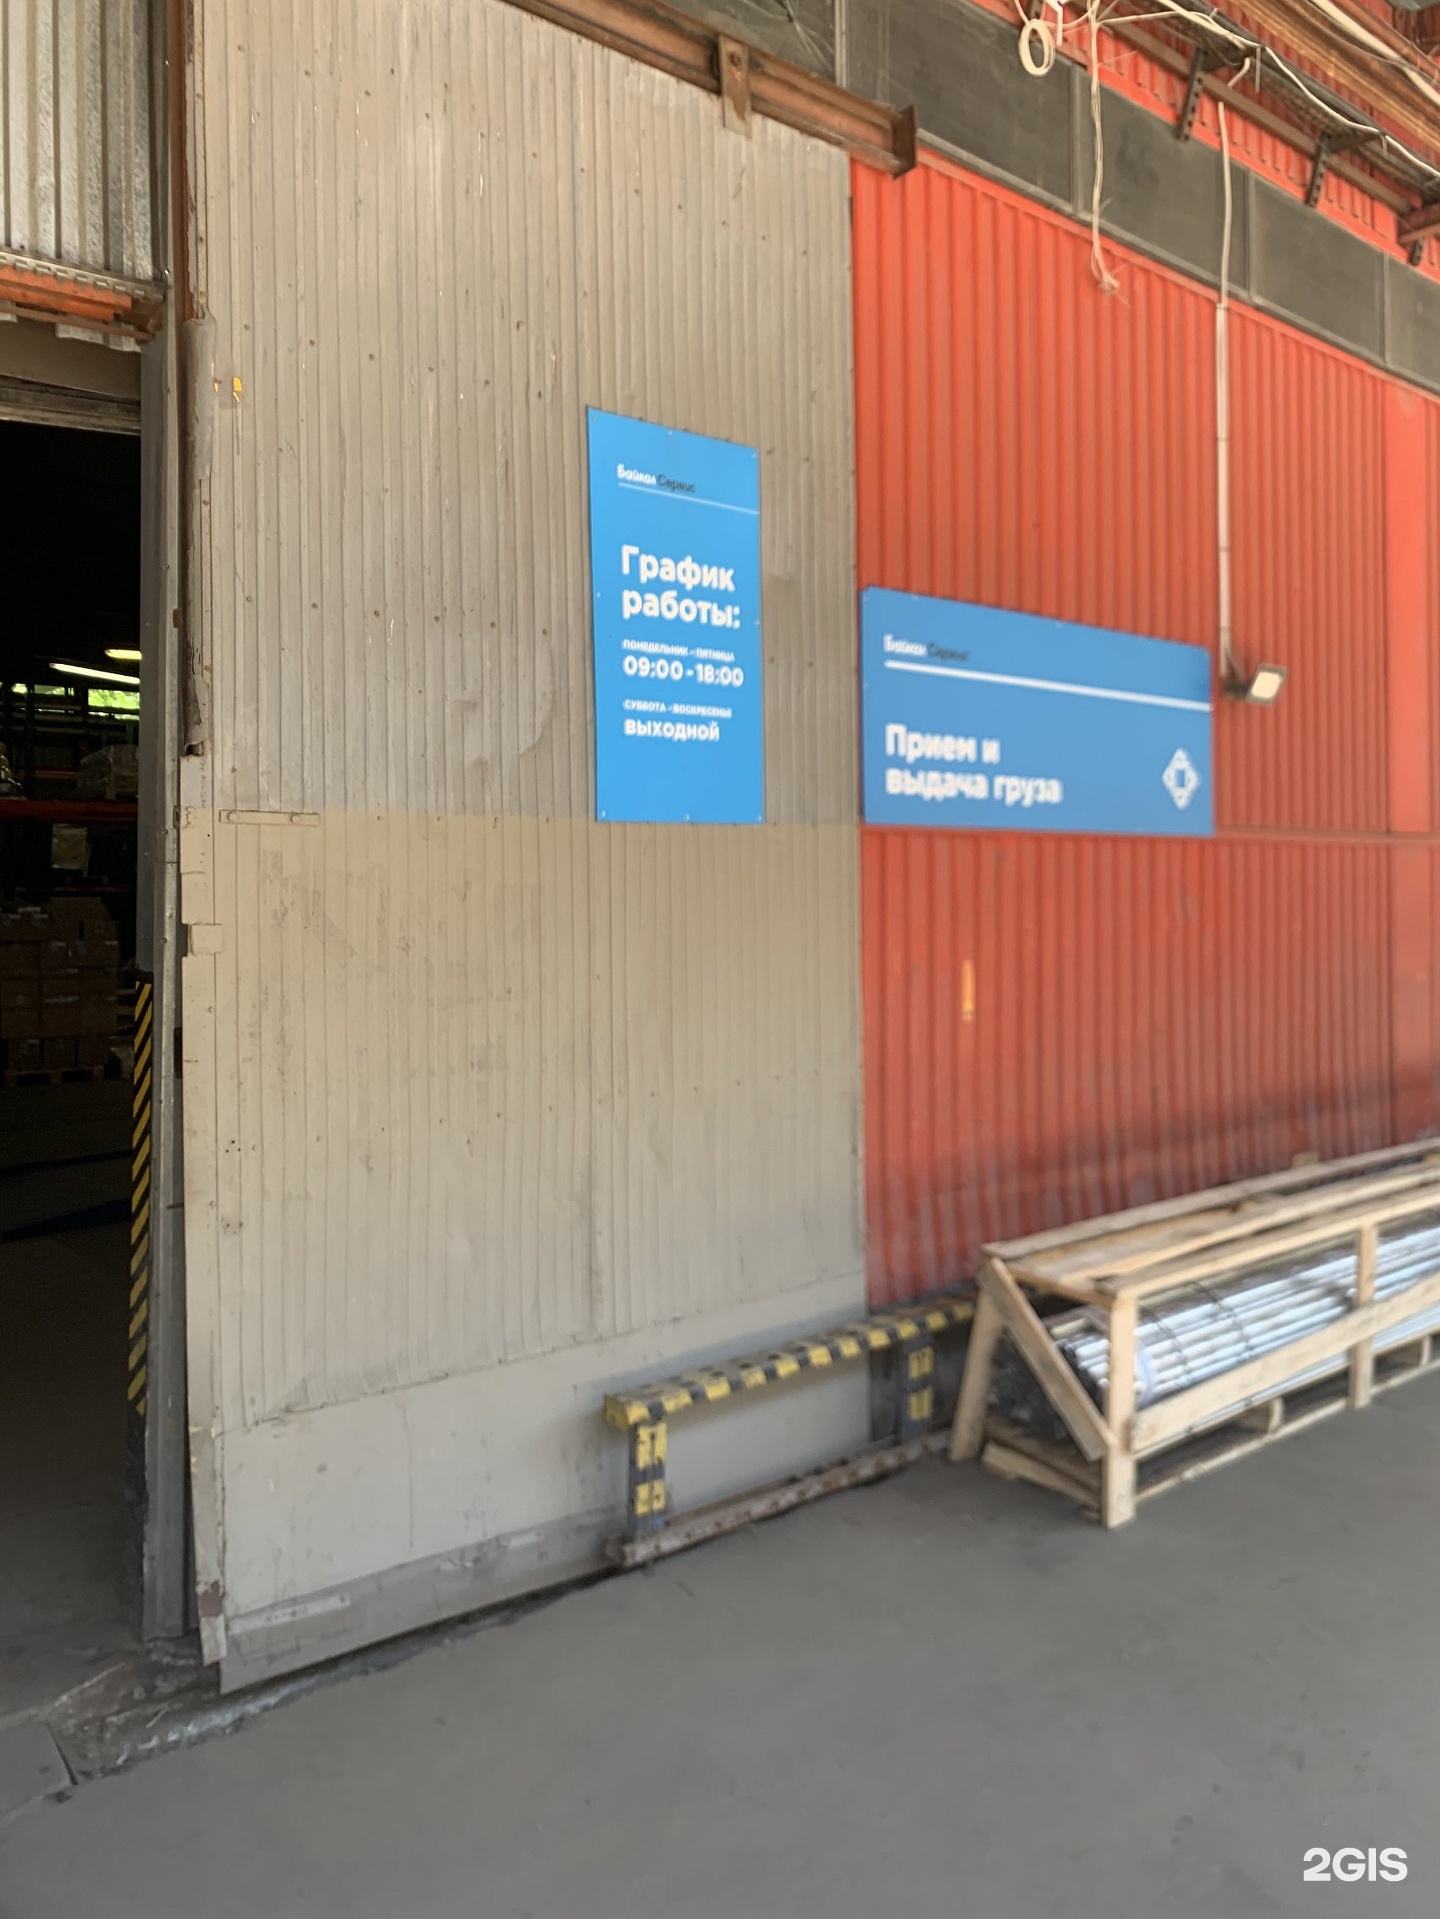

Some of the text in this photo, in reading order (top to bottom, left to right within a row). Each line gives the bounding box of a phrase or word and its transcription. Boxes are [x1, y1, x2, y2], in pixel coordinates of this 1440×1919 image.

[621, 545, 735, 592] График
[622, 590, 740, 629] работы:
[622, 639, 688, 656] ПОНЕДЕЛЬНИК
[696, 648, 735, 662] ПЯТНИЦА
[624, 718, 720, 742] ВЫХОДНОЙ
[885, 724, 1000, 765] Прием и
[885, 768, 1063, 807] выдача груза
